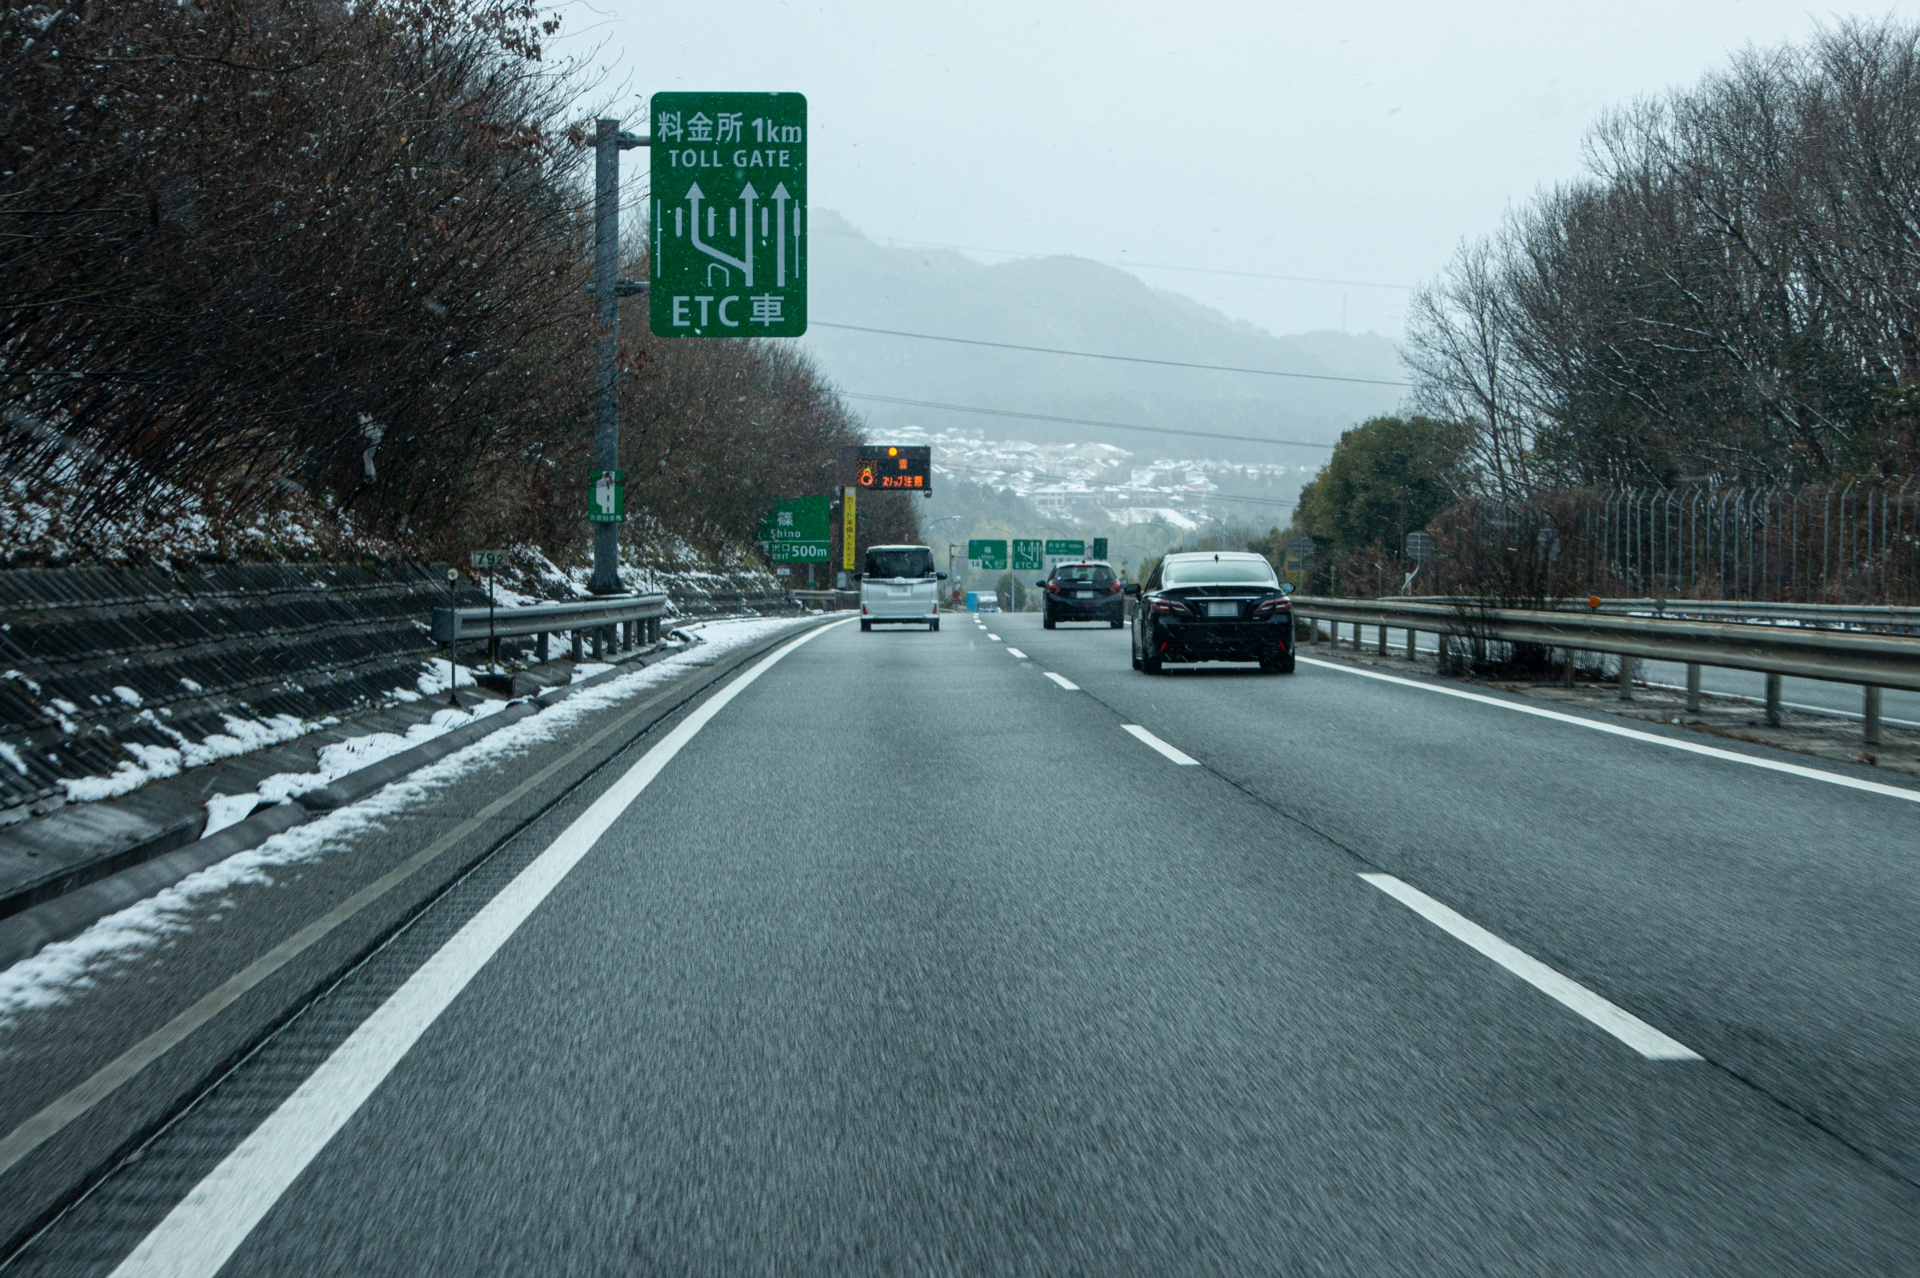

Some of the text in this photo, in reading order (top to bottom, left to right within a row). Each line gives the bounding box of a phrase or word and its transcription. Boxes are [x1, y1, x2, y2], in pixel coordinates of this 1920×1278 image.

[657, 111, 802, 143] 料金所 1km
[669, 149, 790, 168] TOLL GATE
[672, 292, 785, 327] ETC 車
[770, 528, 801, 538] Shino
[476, 552, 504, 565] 792
[791, 545, 827, 557] 500m
